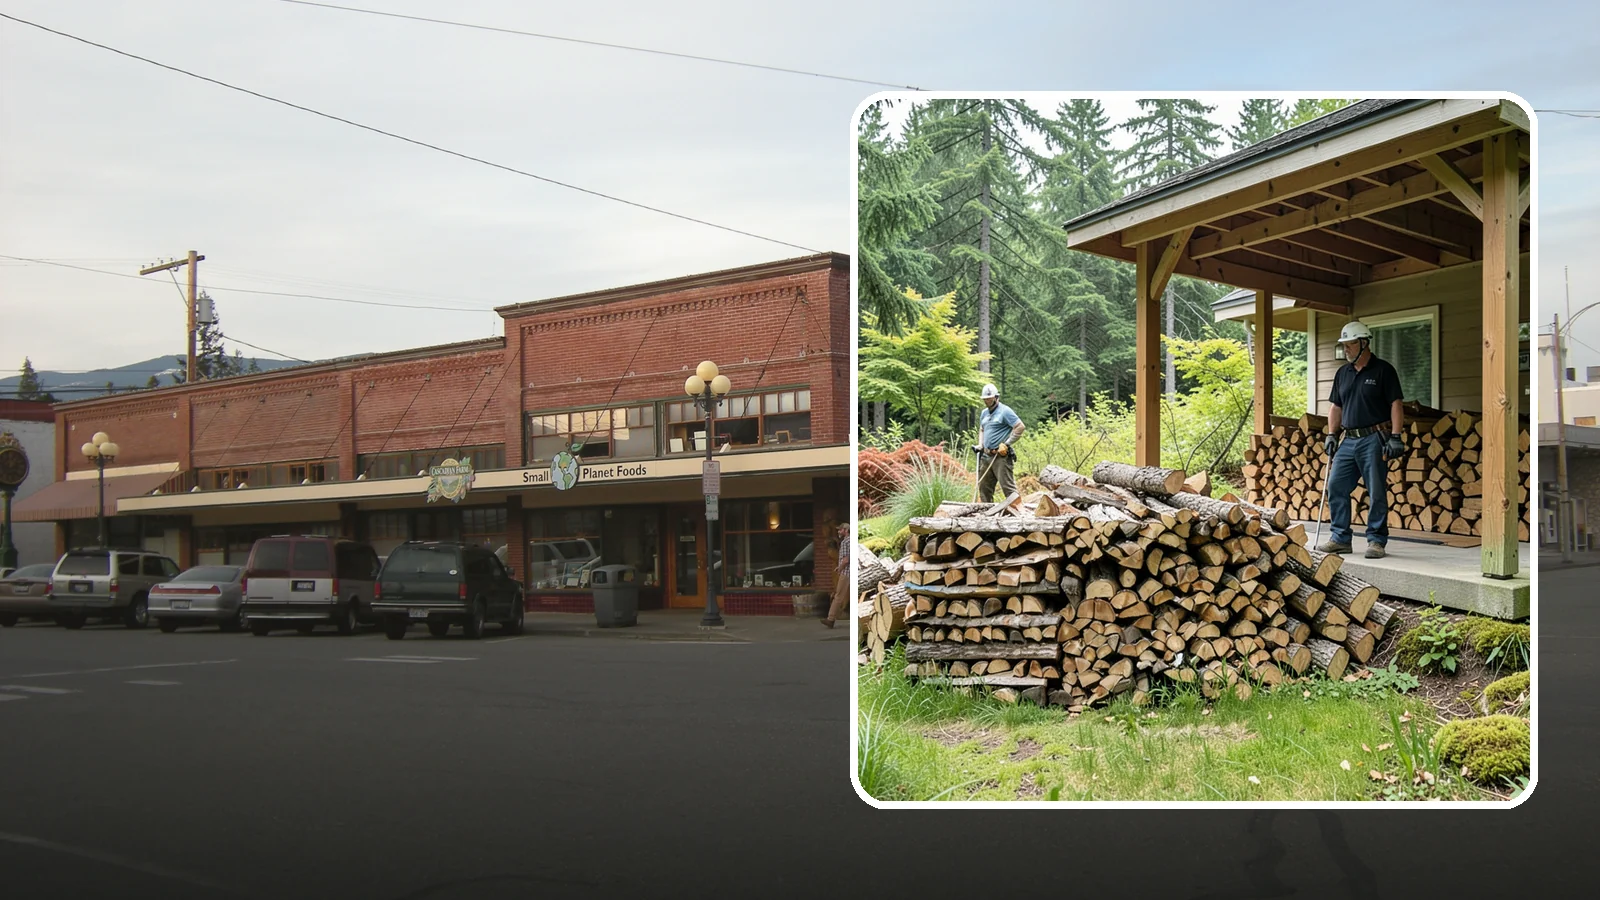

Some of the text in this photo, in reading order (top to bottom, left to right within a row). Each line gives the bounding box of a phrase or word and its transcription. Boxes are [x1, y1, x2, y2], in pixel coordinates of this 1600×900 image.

[523, 464, 647, 483] Small Planet Foods
